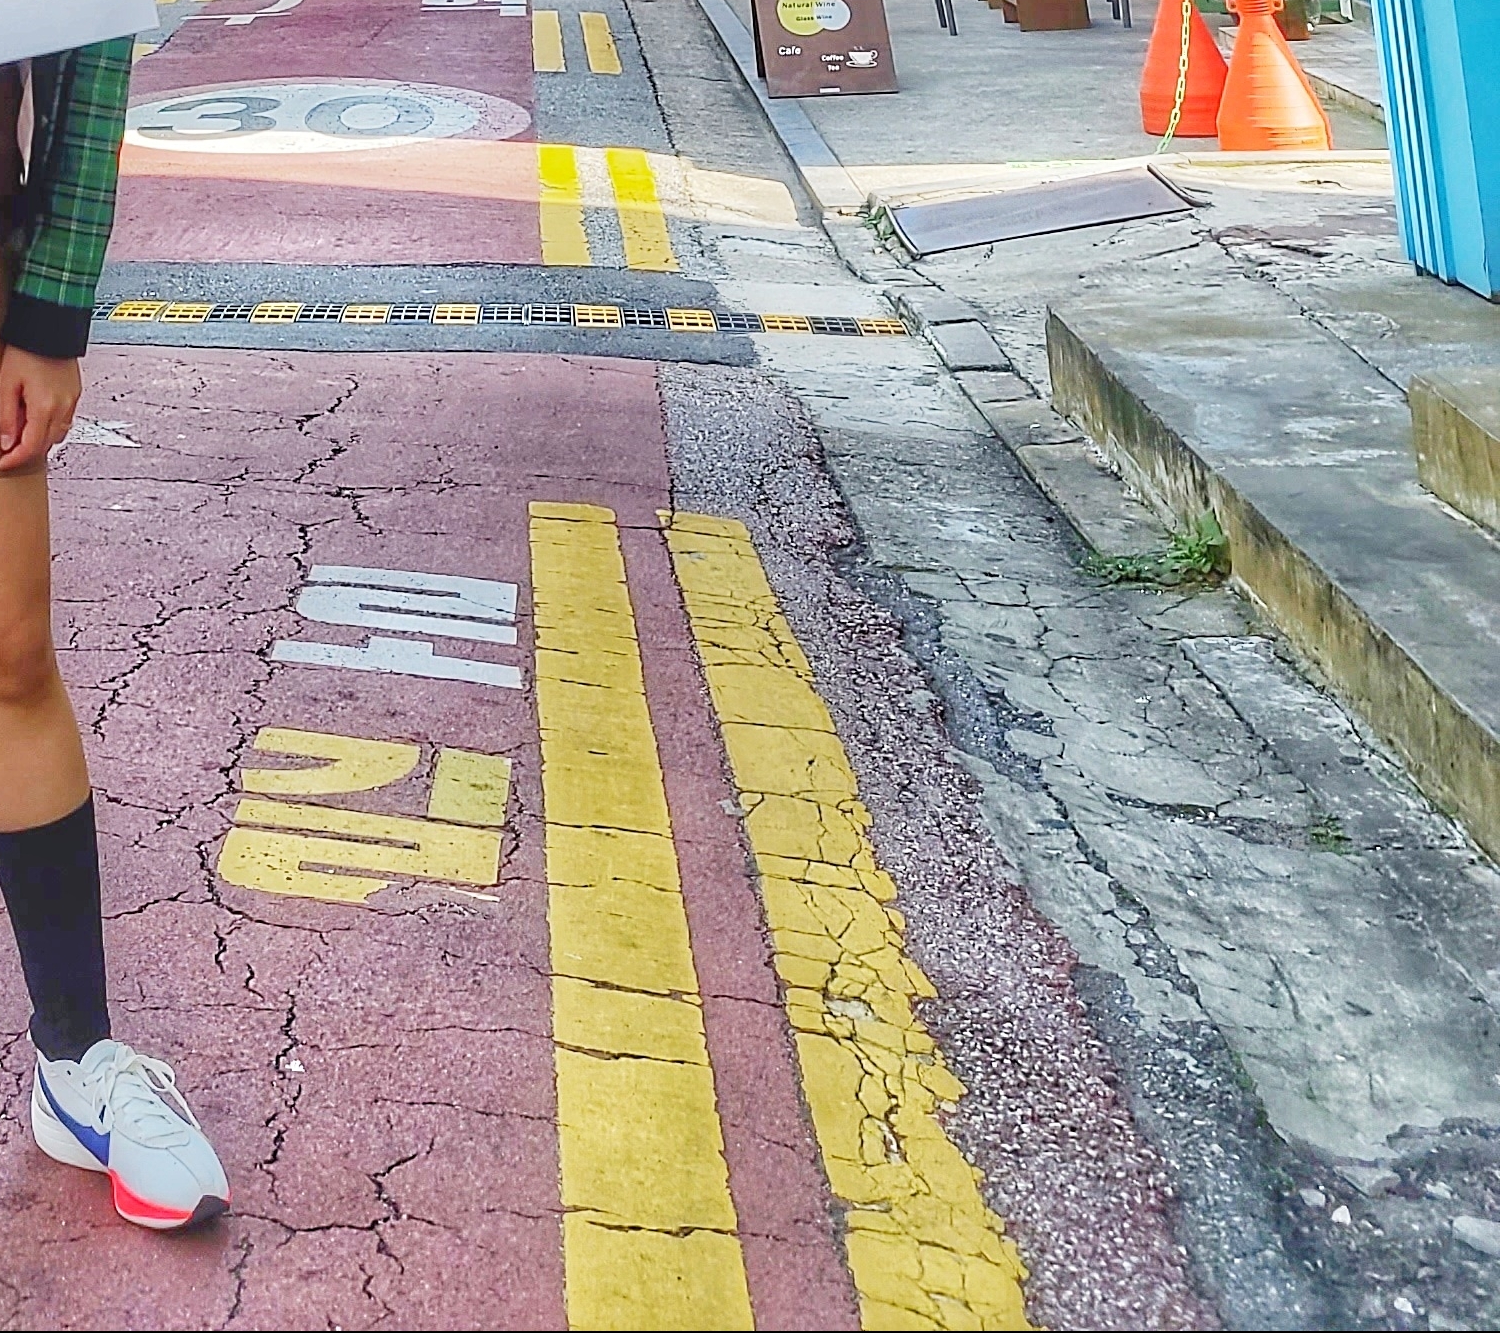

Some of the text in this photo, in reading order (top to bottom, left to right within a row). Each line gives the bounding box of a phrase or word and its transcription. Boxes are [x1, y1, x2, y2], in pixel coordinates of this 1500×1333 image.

[781, 0, 836, 9] Natural Wine
[778, 45, 802, 56] Cafe
[138, 95, 436, 141] 30
